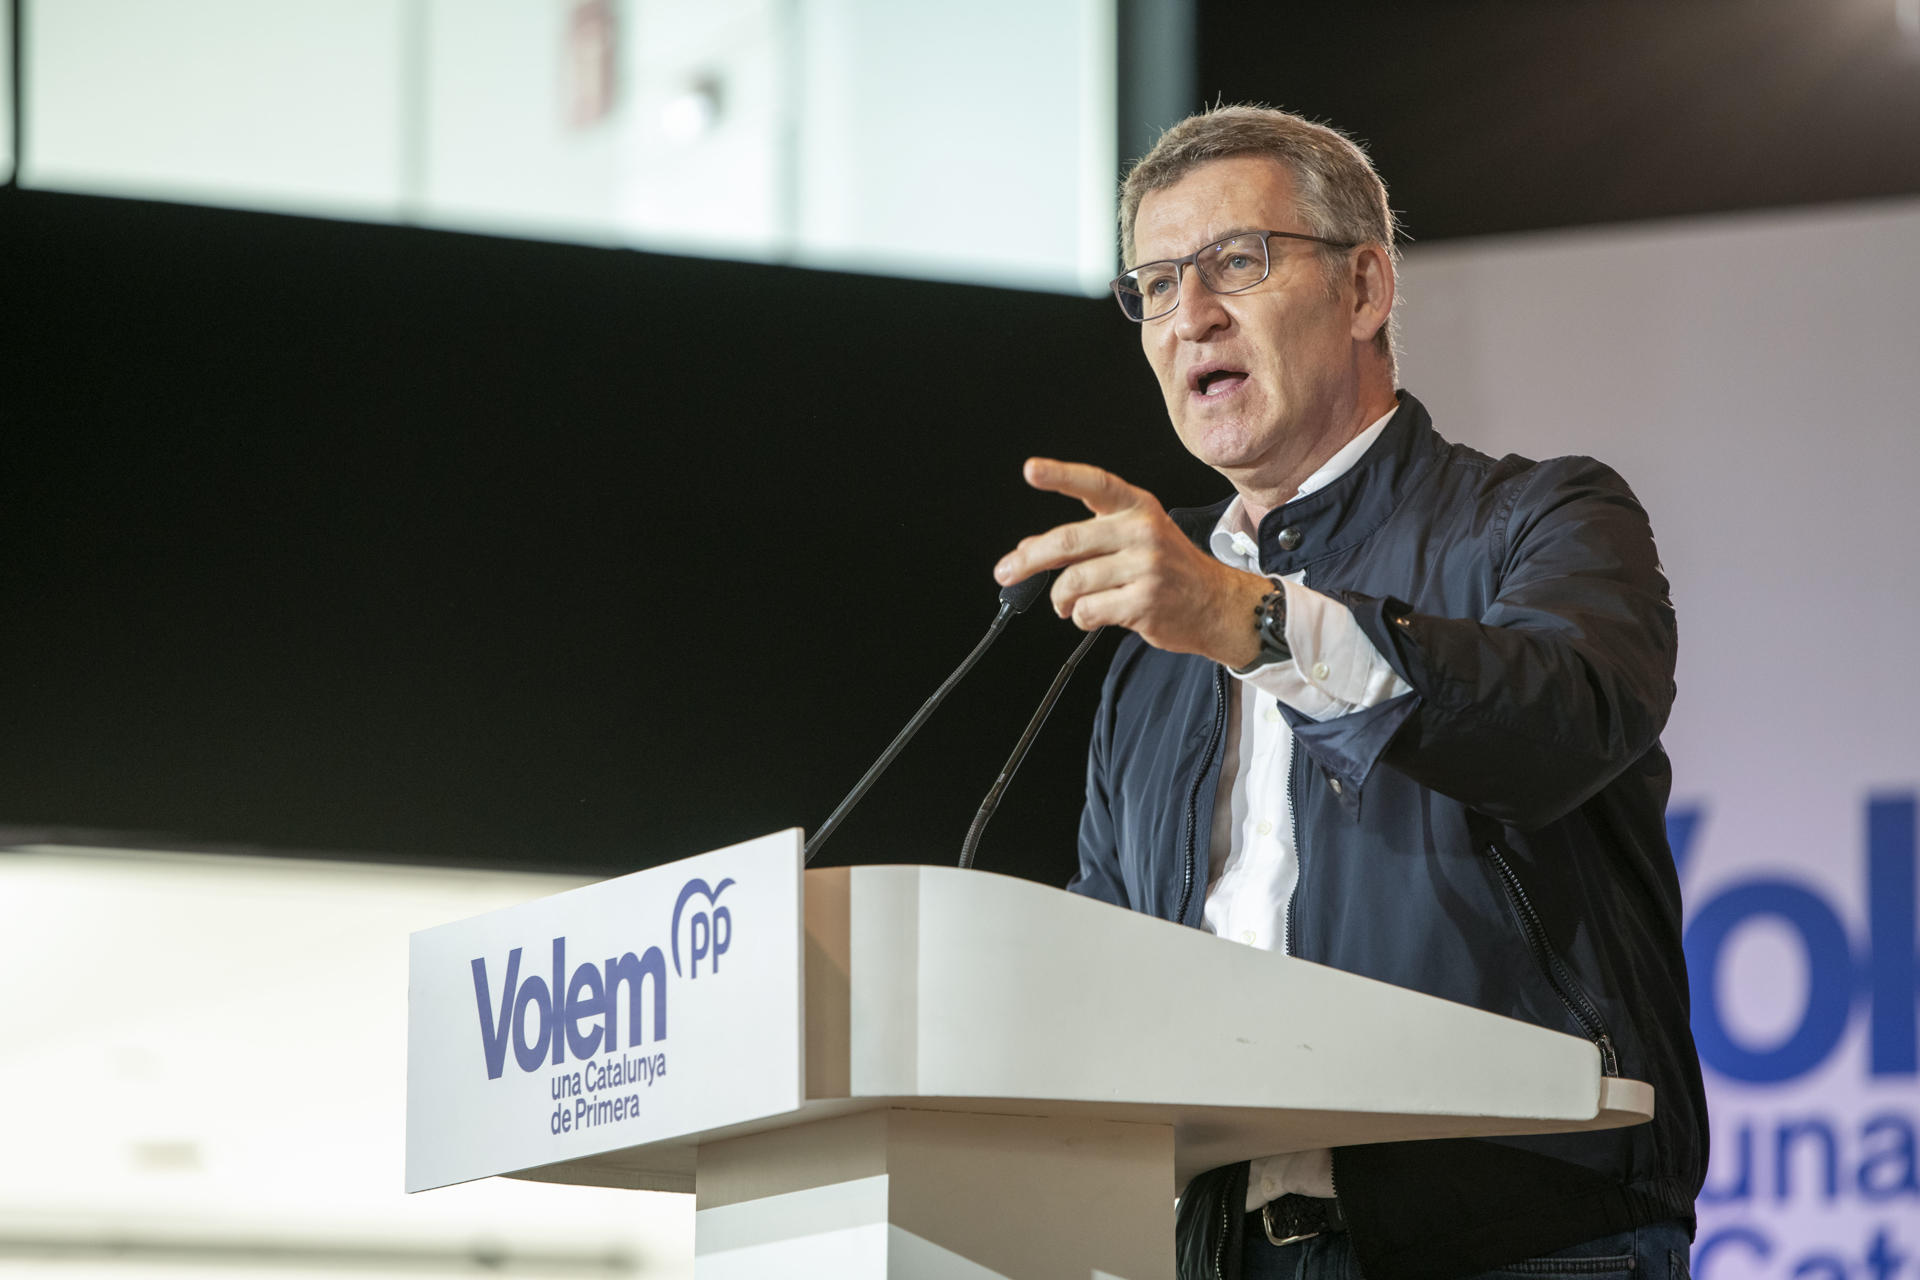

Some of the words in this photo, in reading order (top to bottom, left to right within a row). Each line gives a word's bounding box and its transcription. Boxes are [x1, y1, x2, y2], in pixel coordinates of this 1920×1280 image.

[471, 937, 666, 1079] Volem
[551, 1073, 581, 1100] una
[585, 1052, 666, 1092] Catalunya
[551, 1102, 571, 1135] de
[575, 1094, 640, 1131] Primera
